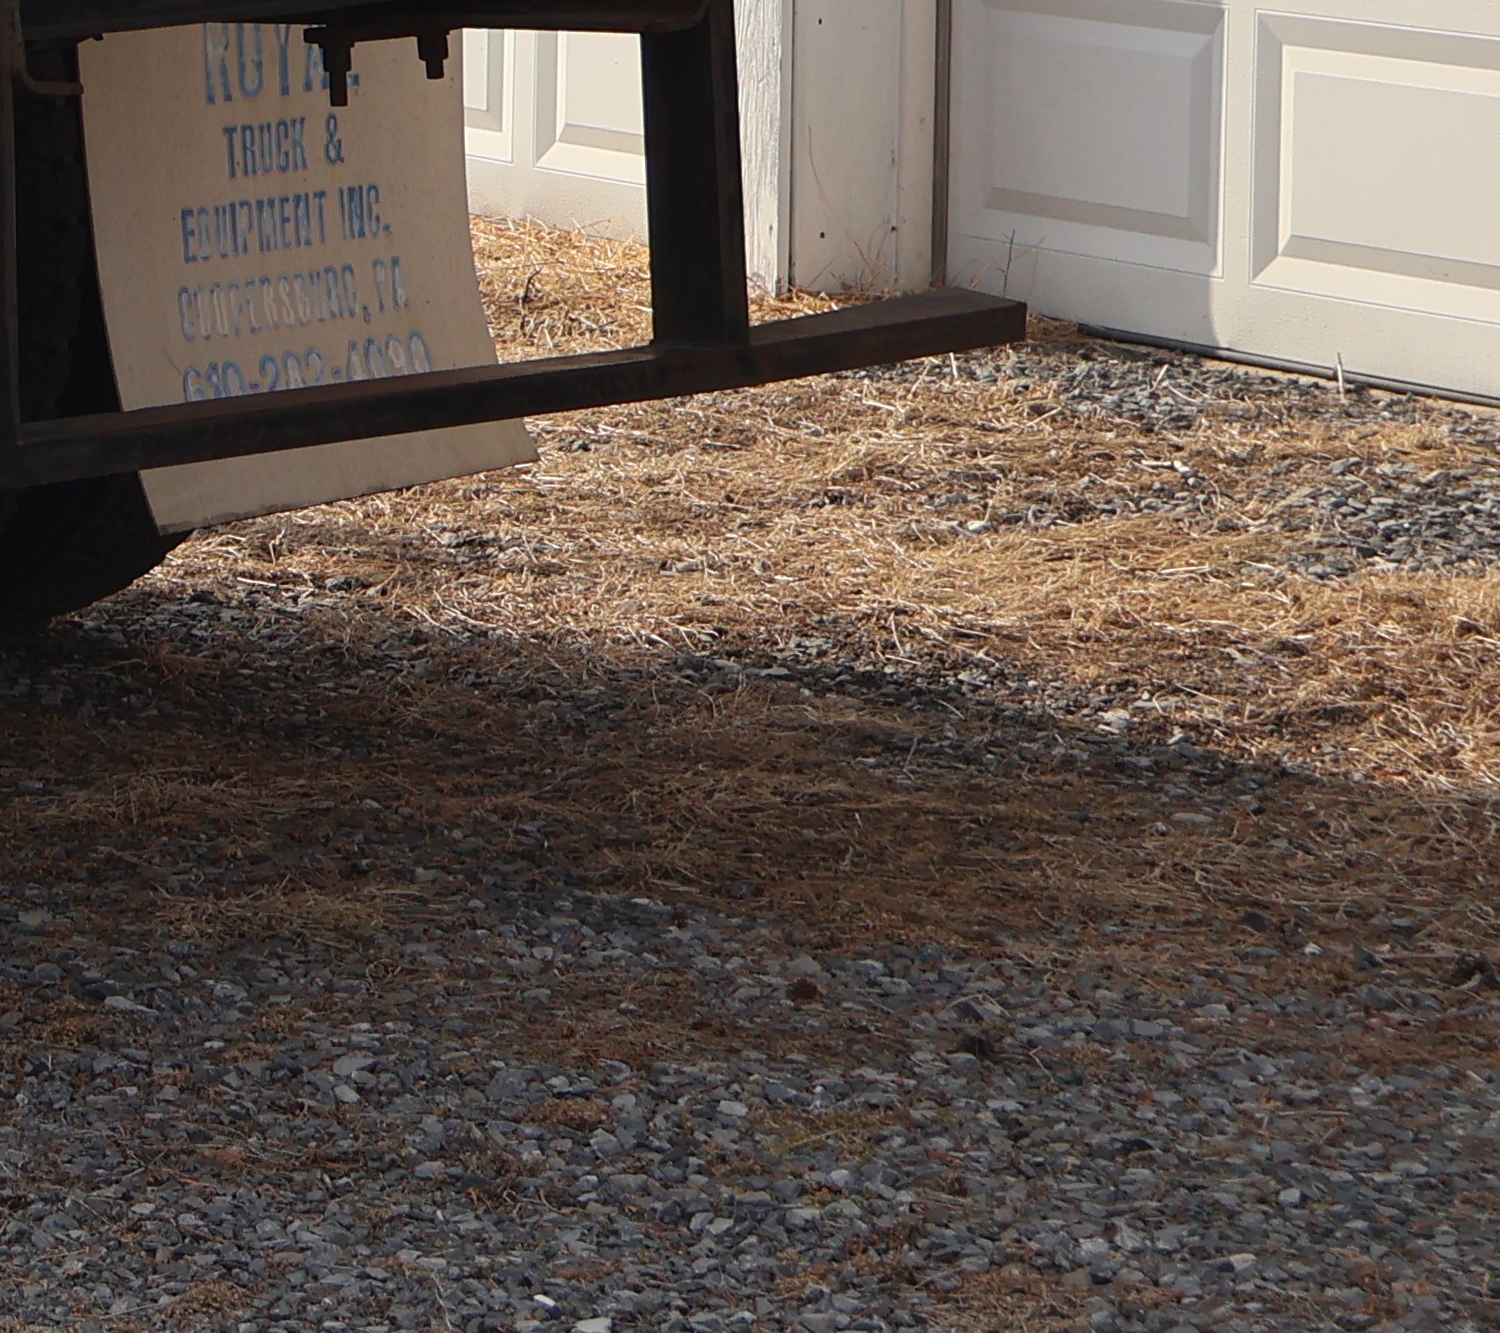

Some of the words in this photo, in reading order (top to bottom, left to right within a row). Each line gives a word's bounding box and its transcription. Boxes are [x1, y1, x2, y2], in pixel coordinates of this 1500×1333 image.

[223, 116, 308, 180] TRUCK
[324, 113, 346, 167] &
[181, 190, 328, 264] EQUIPMENT
[338, 183, 393, 242] INC.
[372, 254, 411, 314] PA
